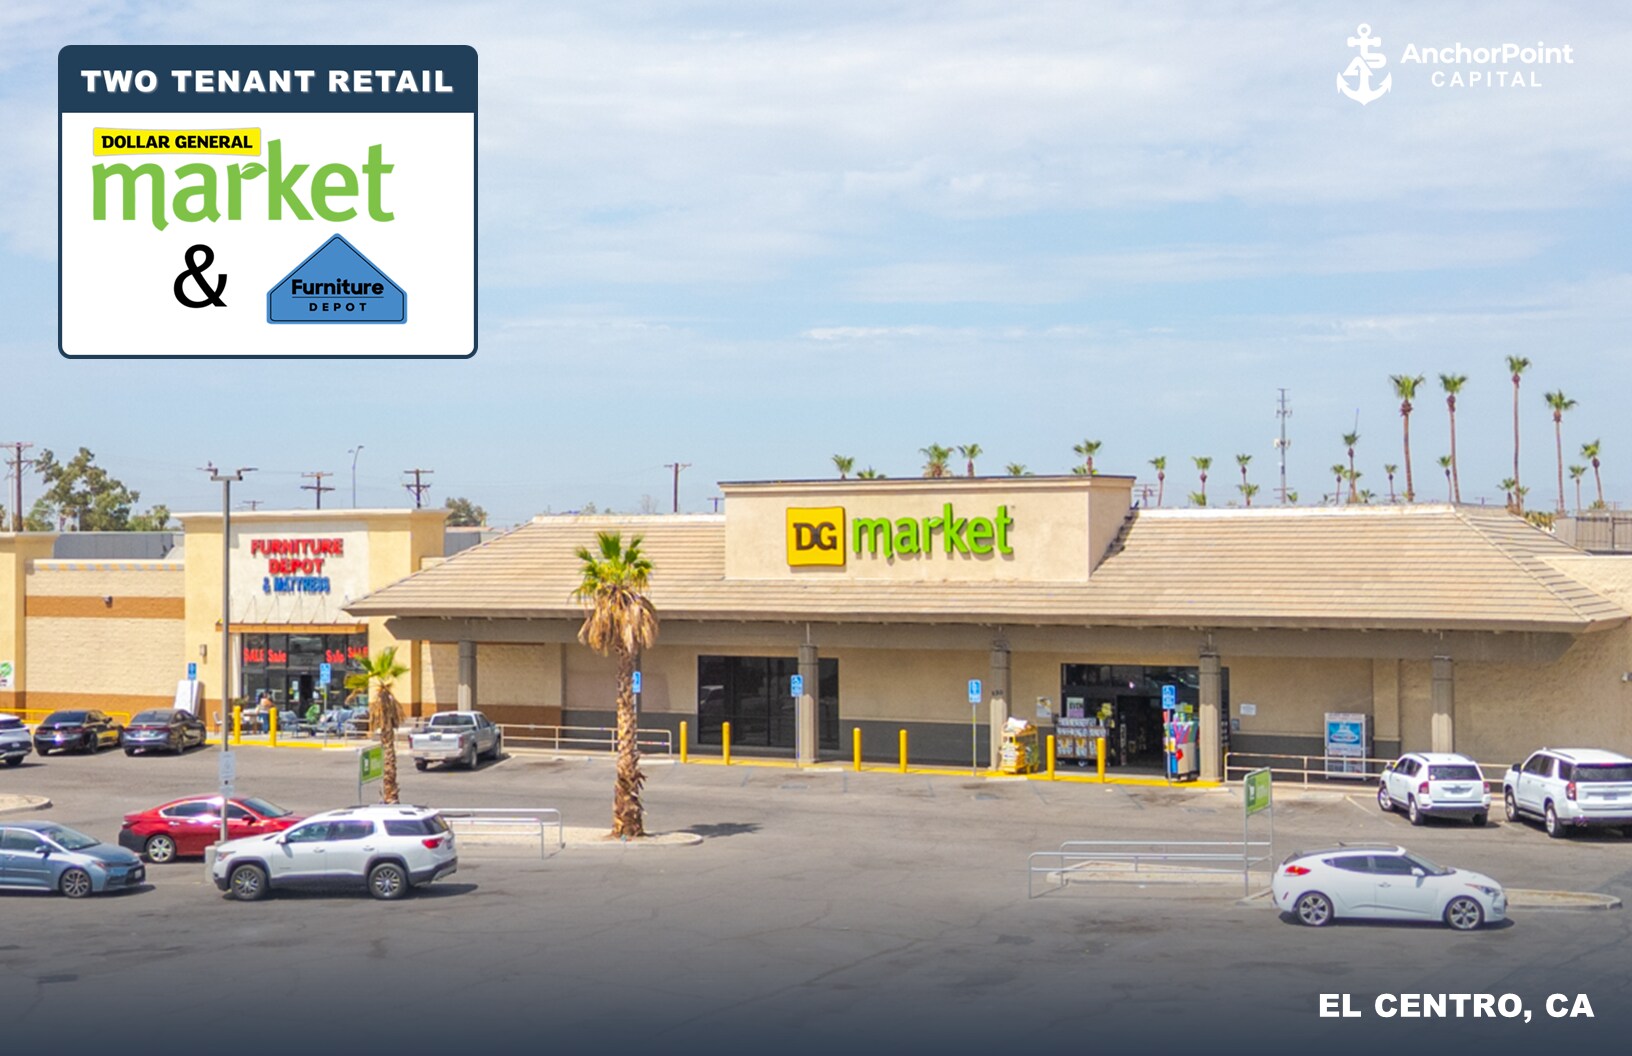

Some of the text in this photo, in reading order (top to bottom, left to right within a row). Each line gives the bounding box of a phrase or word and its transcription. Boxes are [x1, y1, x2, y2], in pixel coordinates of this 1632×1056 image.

[793, 502, 1014, 559] DG market
[250, 538, 344, 556] FURNITURE
[268, 558, 324, 574] DEPOT
